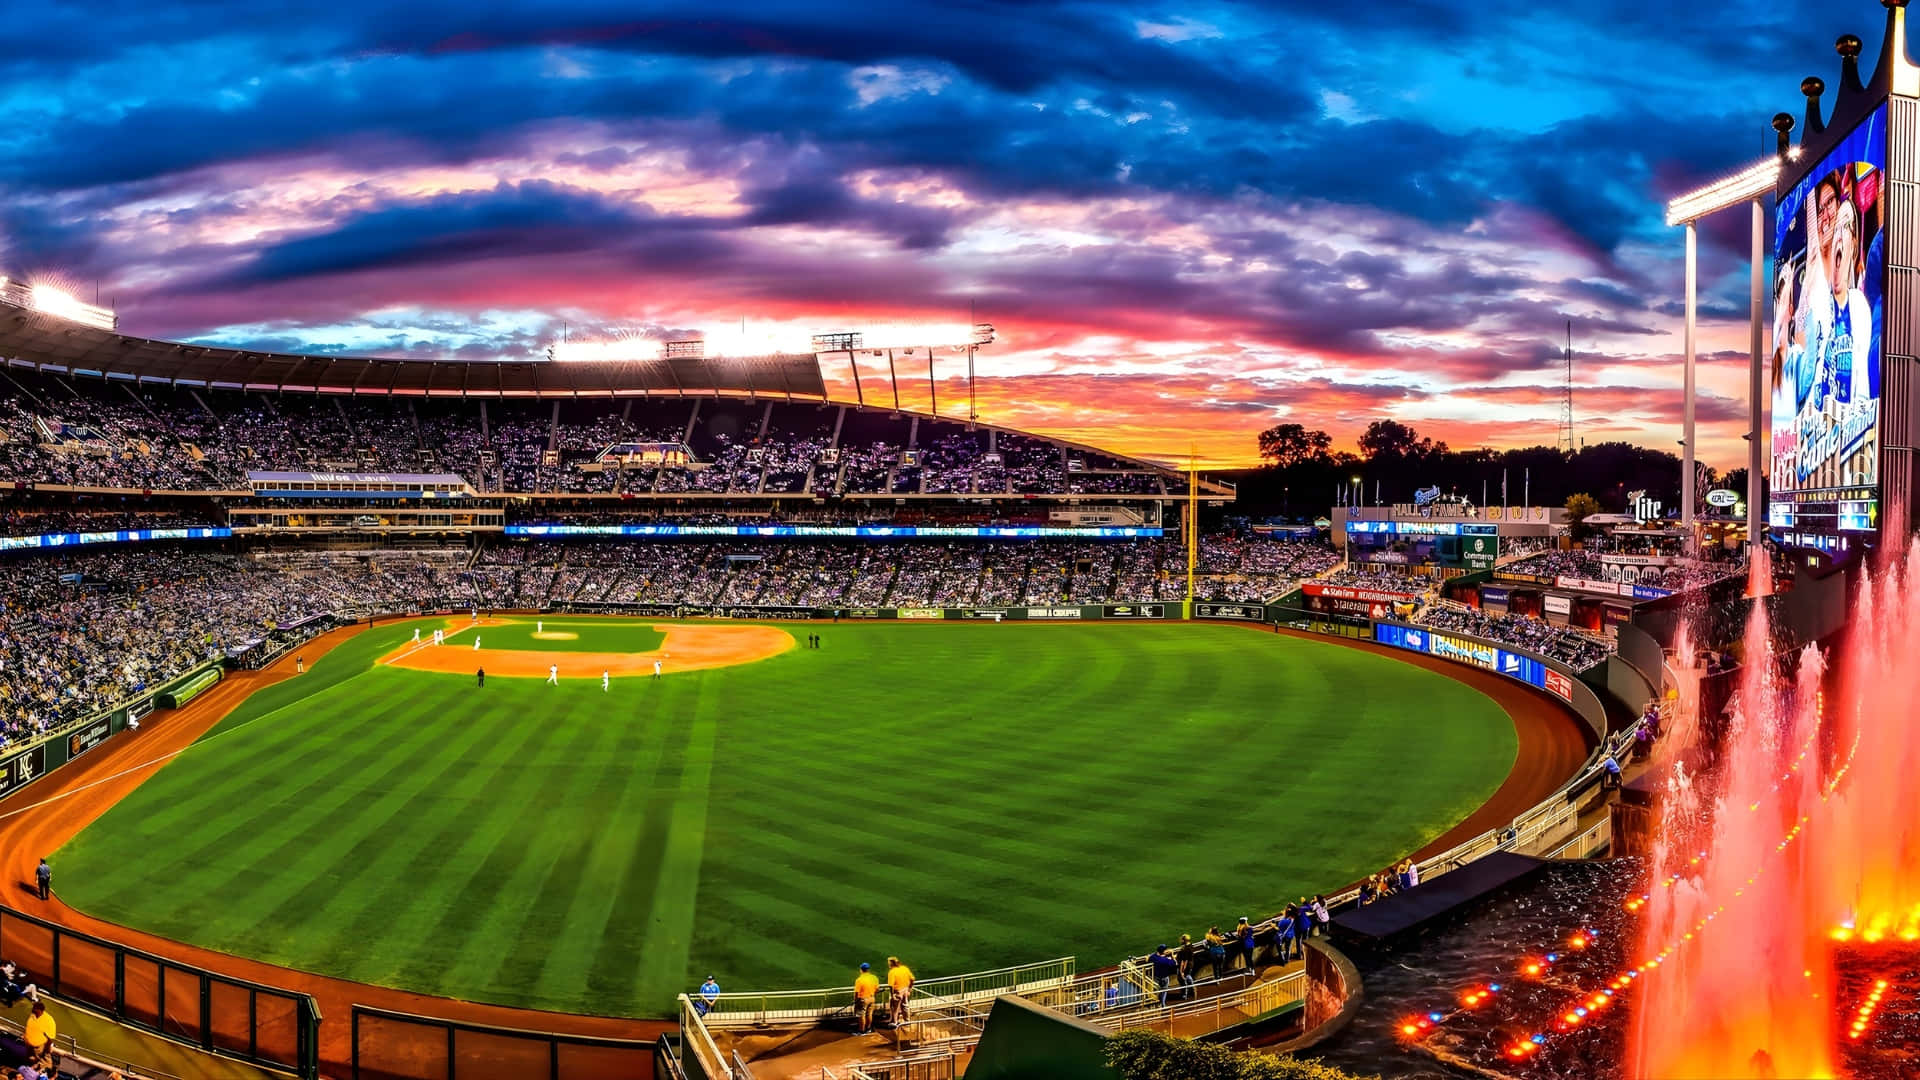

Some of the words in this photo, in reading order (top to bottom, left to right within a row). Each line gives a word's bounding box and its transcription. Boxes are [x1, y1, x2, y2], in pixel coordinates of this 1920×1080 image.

[1392, 503, 1421, 517] HALL
[1432, 503, 1465, 517] FAME
[1634, 496, 1661, 525] Lite
[1463, 551, 1494, 561] Commerce
[1471, 559, 1486, 568] Bank
[19, 752, 33, 780] KC
